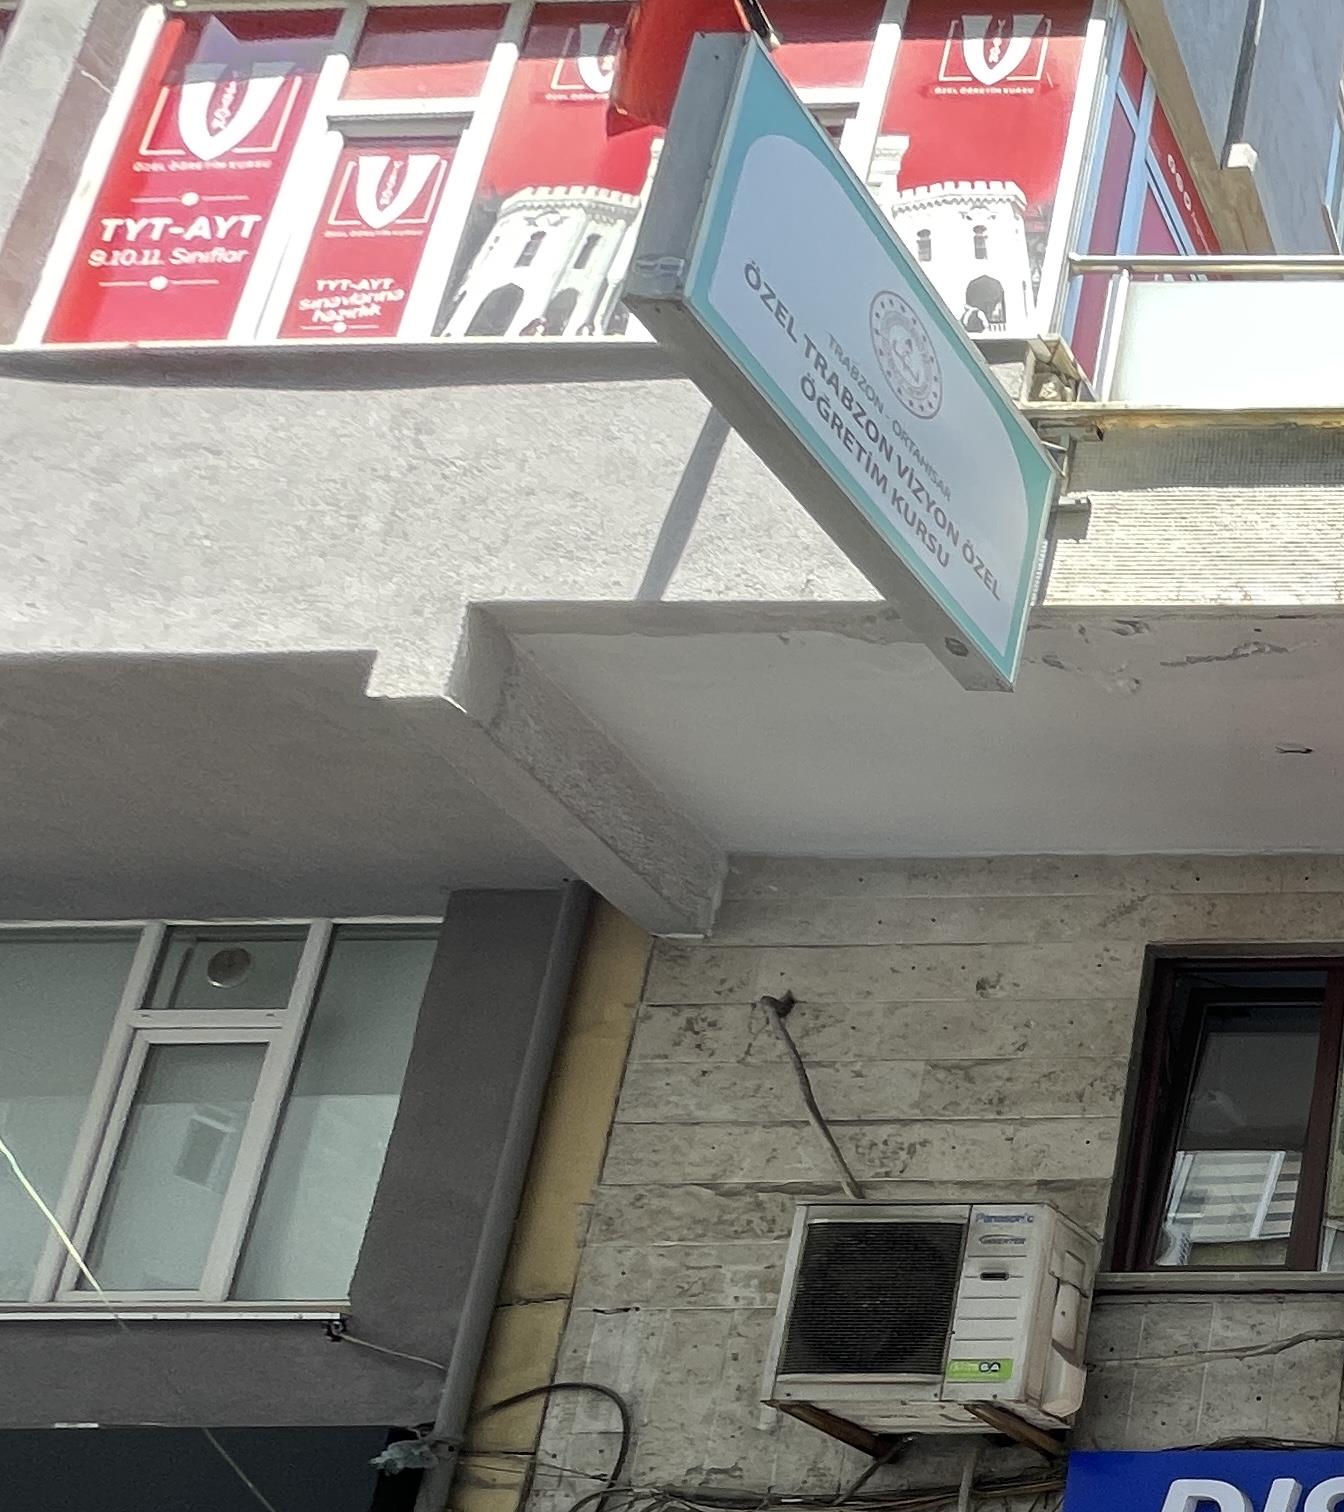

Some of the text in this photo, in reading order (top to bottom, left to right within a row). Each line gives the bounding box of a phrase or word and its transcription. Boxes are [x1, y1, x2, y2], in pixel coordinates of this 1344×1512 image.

[100, 213, 263, 242] TYT-AYT
[743, 259, 799, 345] ÖZEL
[802, 332, 894, 464] TRABZON
[895, 452, 960, 549] VİZYON
[961, 536, 1002, 602] ÖZEL
[800, 371, 889, 495] ÖĞRETİM
[890, 485, 951, 569] KURSU
[975, 1212, 1035, 1224] Panasonic
